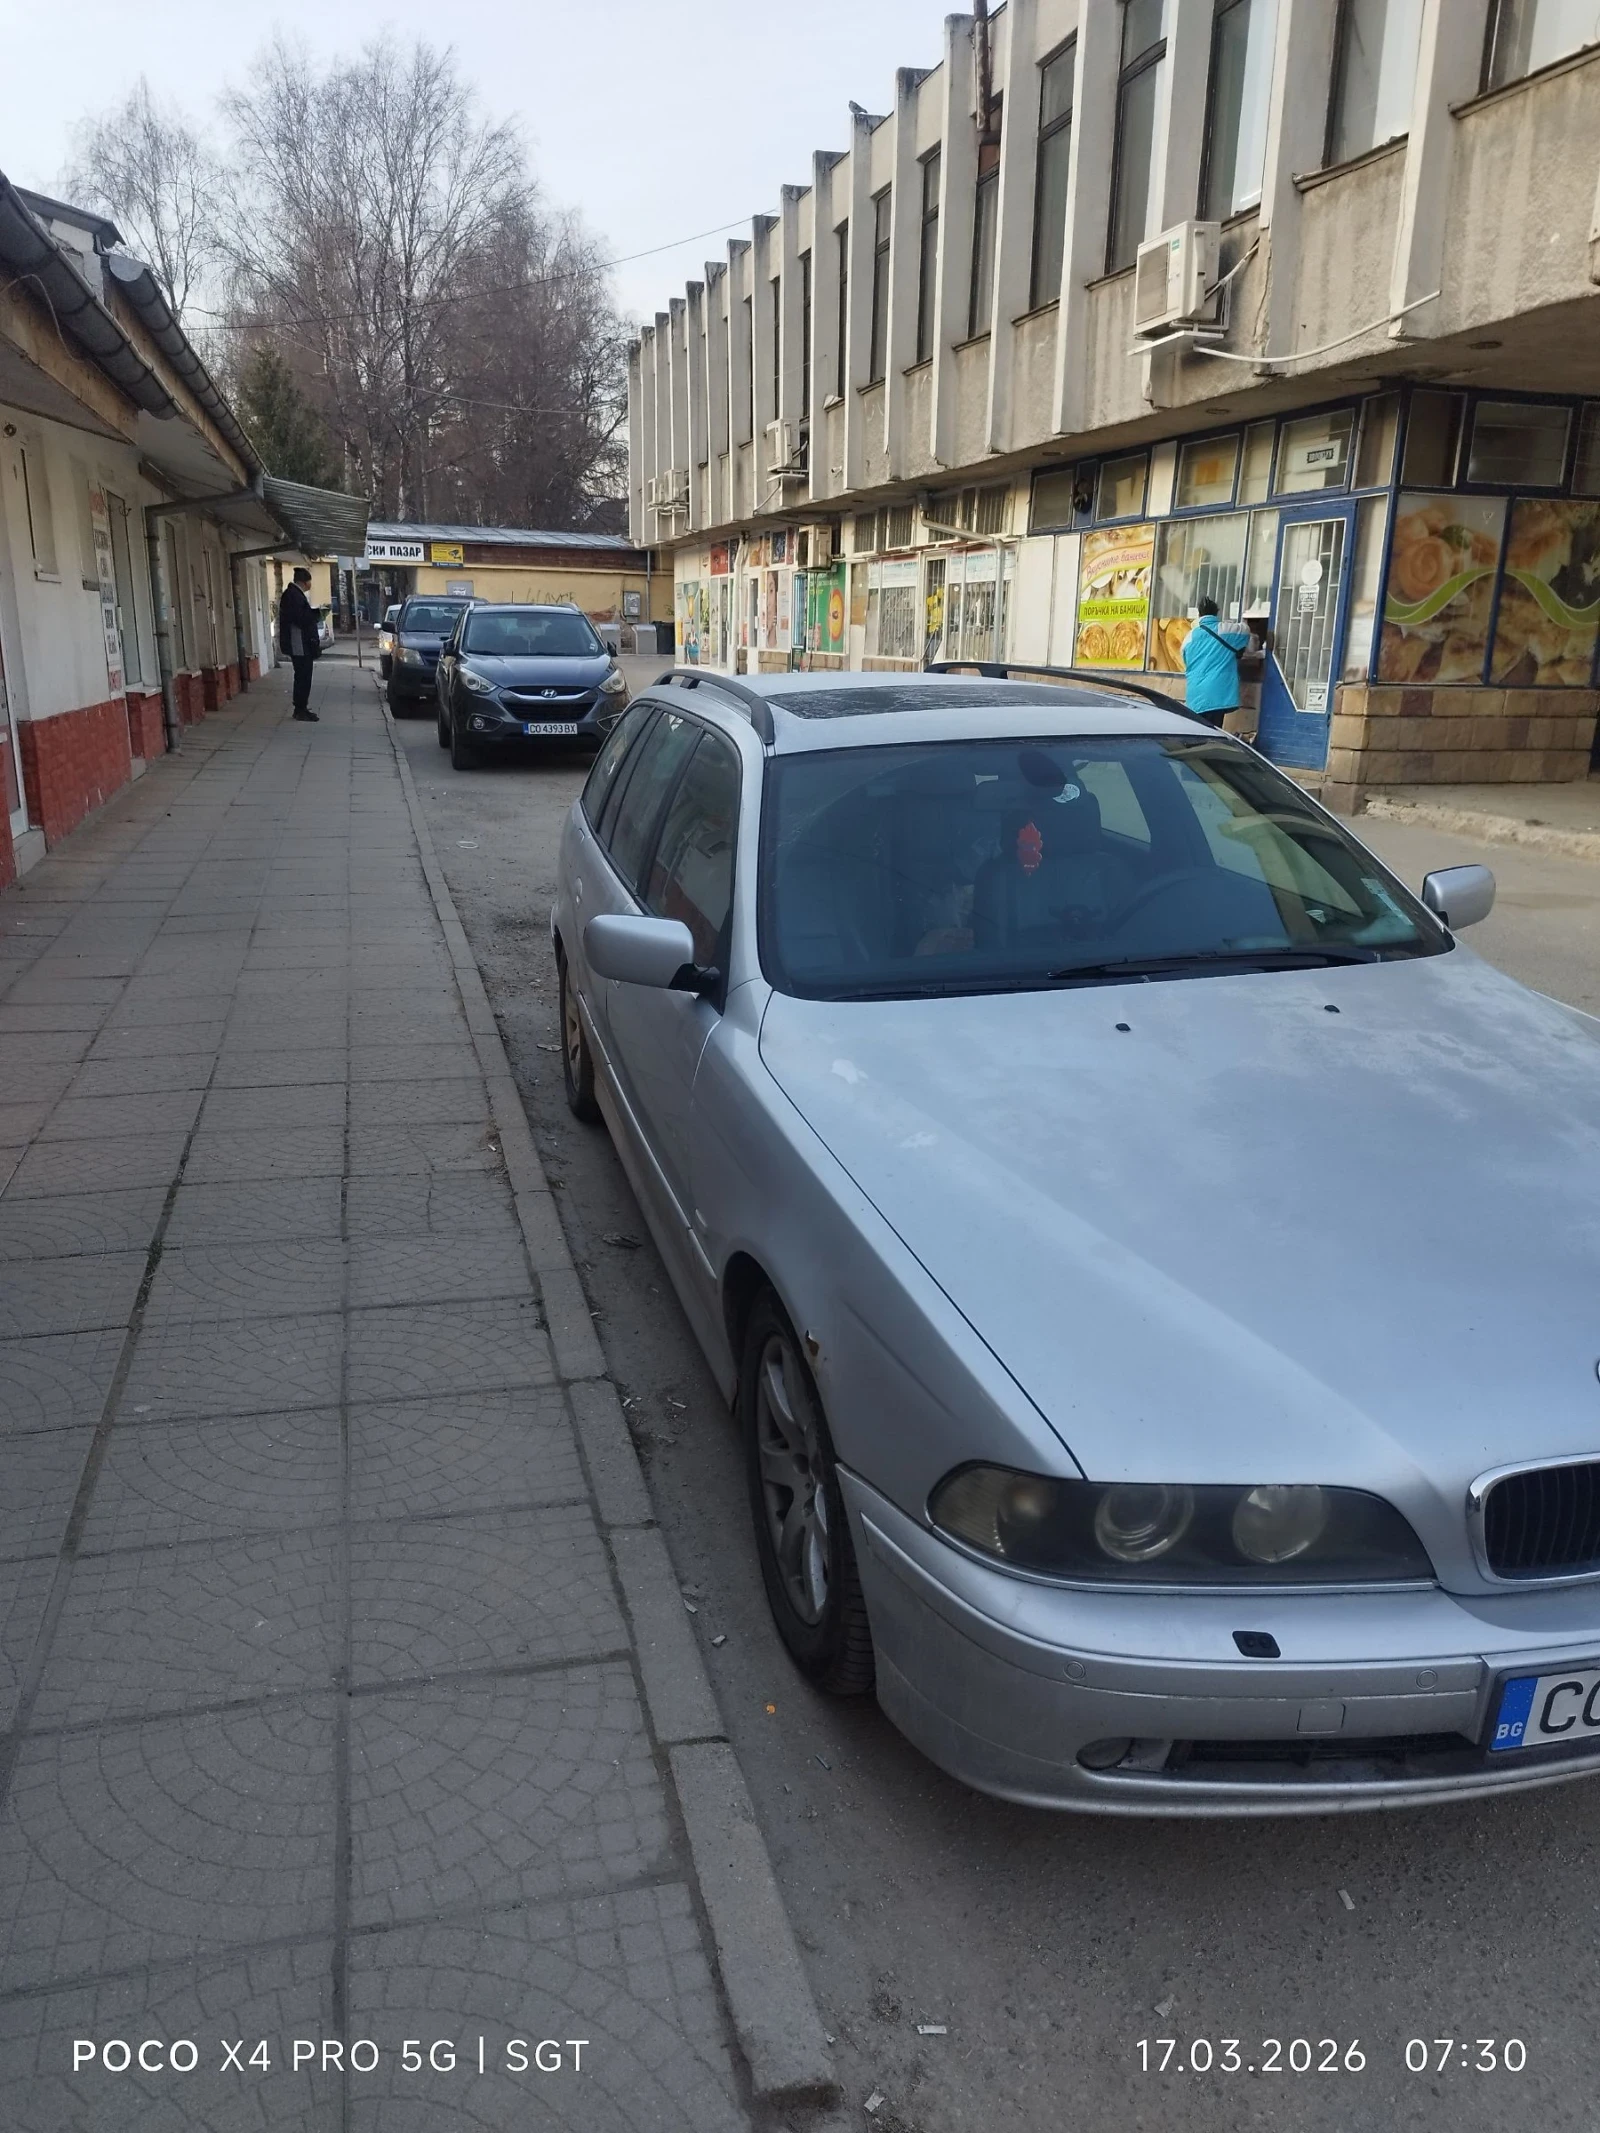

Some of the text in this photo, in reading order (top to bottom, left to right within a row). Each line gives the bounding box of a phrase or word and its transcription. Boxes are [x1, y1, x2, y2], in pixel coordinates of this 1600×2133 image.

[389, 545, 422, 557] ПАЗАР
[1084, 604, 1146, 616] ПОРЪЧКА НА БАНИЦИ
[543, 724, 563, 733] 4393
[1496, 1721, 1523, 1740] BG
